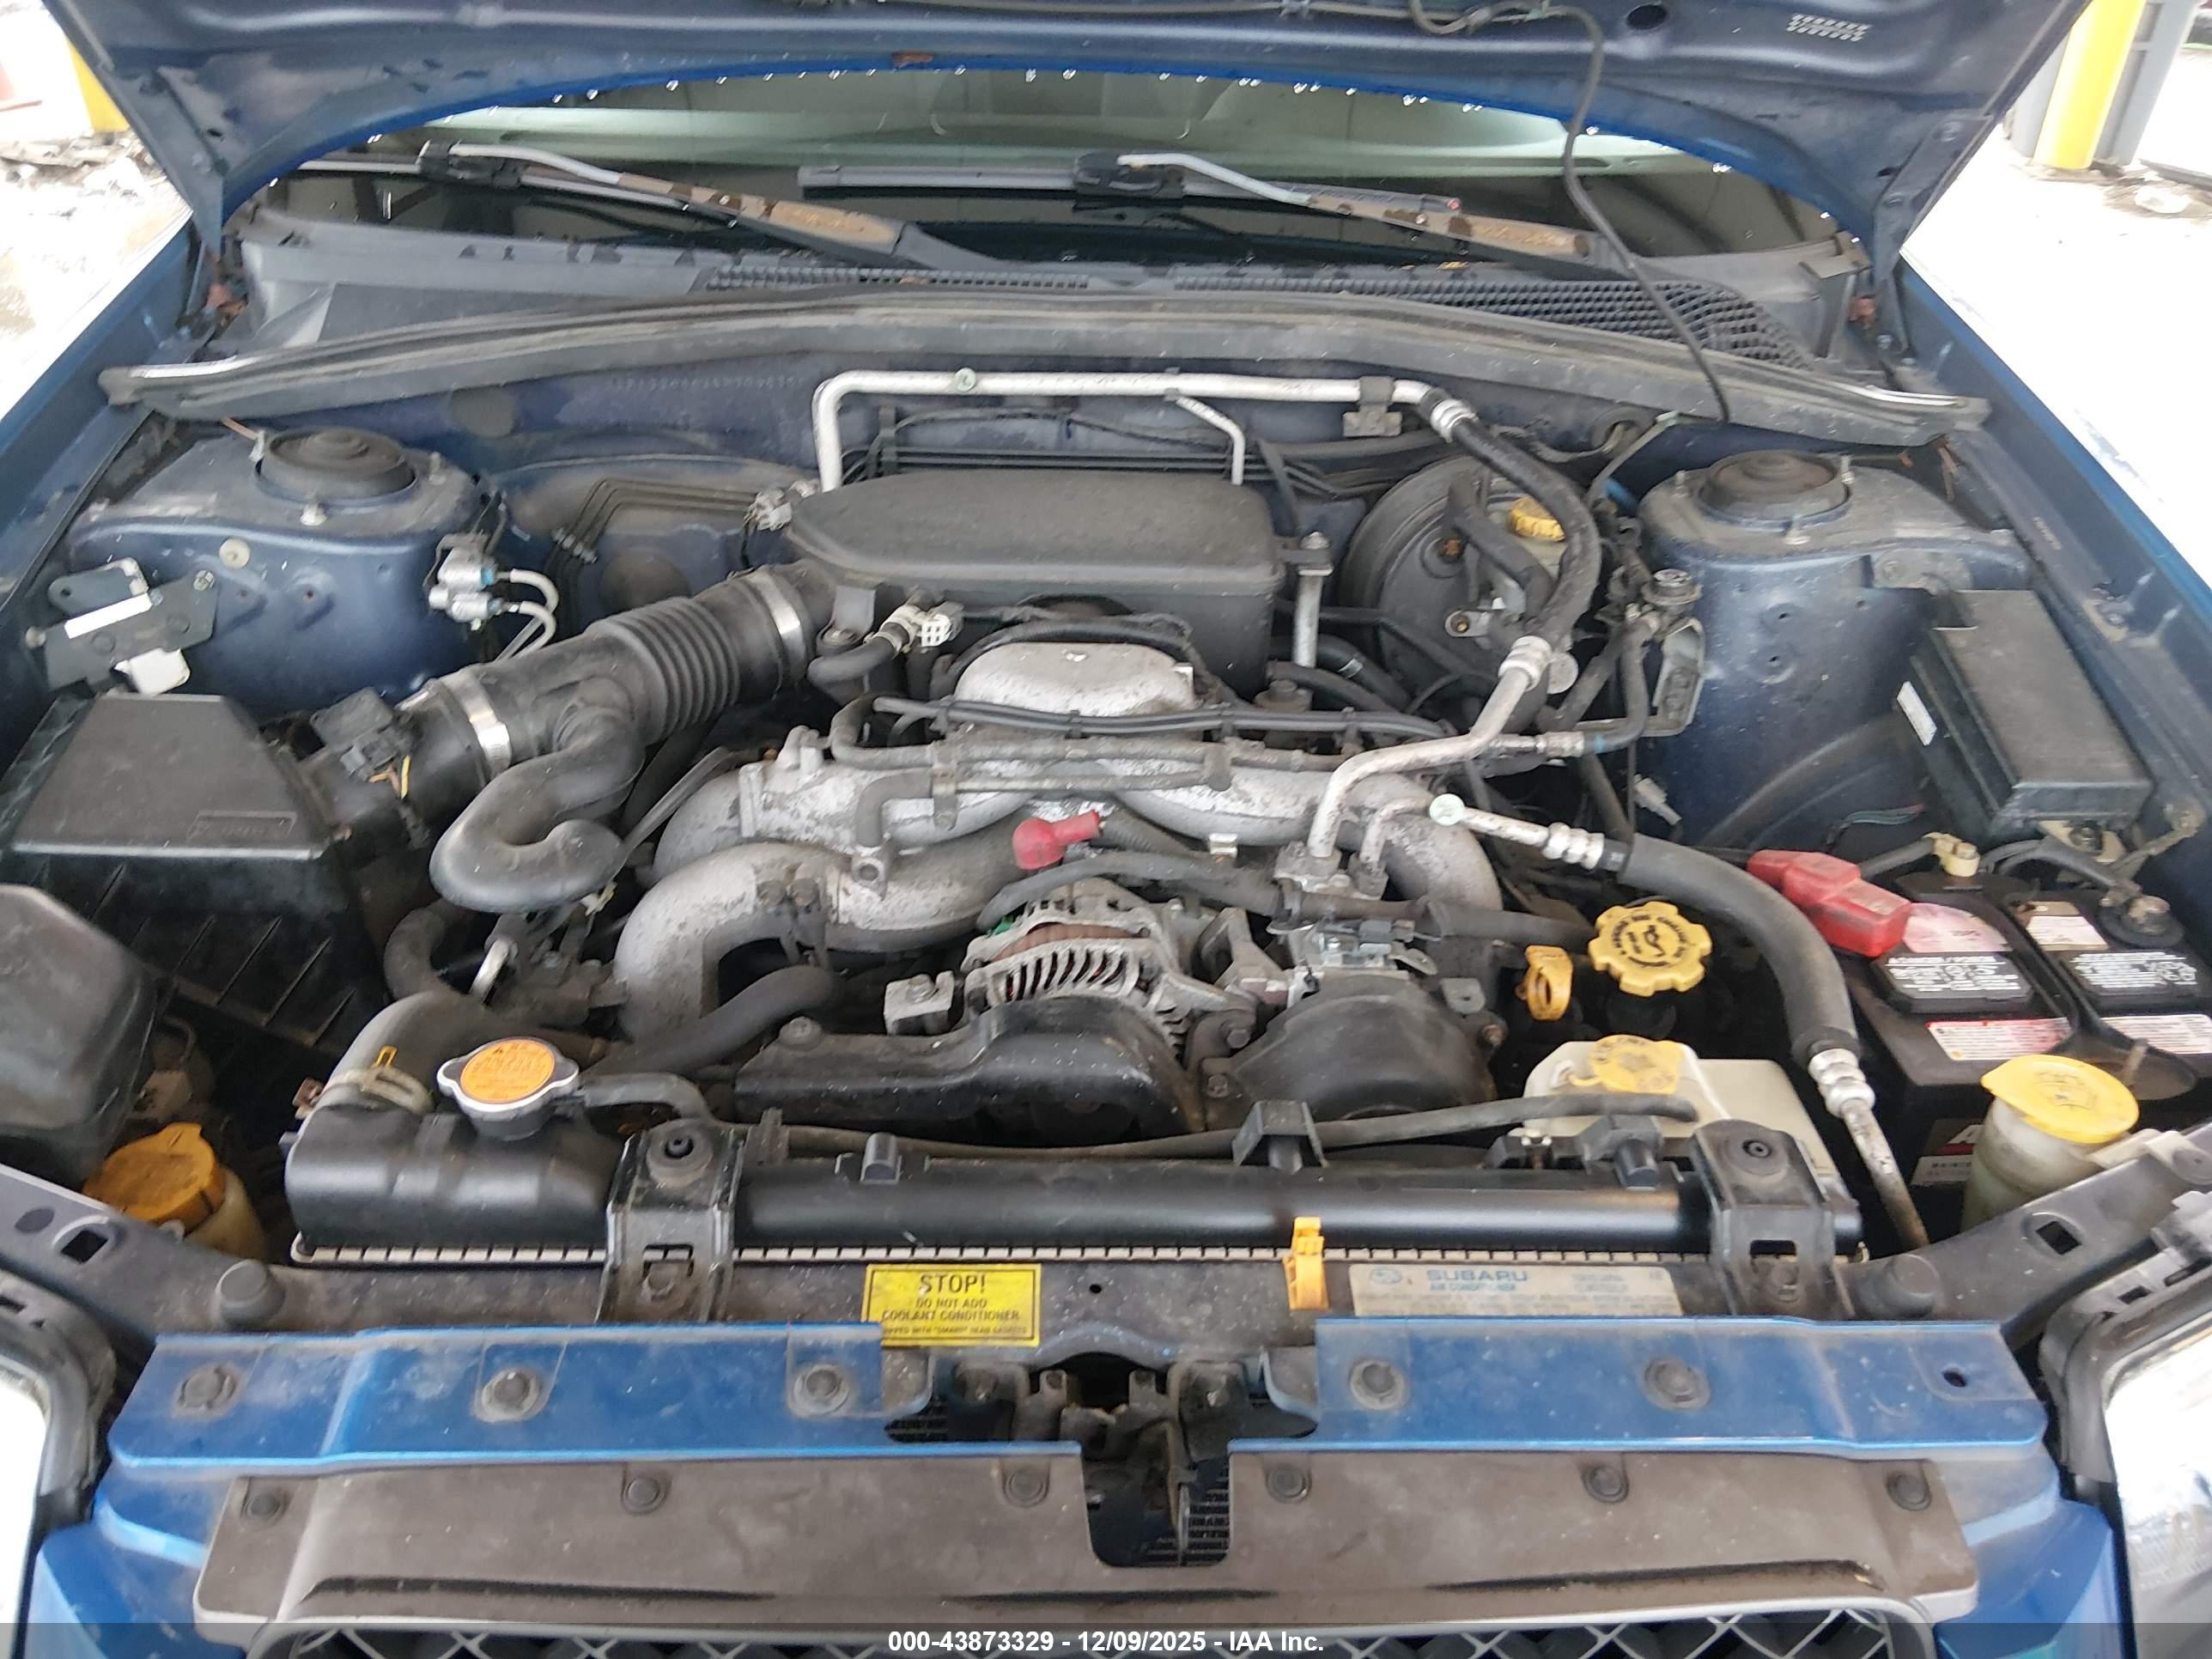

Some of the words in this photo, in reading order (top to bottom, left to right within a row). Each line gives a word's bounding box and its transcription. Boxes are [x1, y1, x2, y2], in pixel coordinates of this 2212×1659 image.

[1426, 1270, 1528, 1282] SUBARU
[919, 1274, 986, 1293] STOP!
[915, 1297, 932, 1308] DO
[936, 1297, 958, 1308] NOT
[962, 1297, 988, 1308] ADD
[881, 1310, 936, 1322] COOLANT
[939, 1310, 1020, 1321] CONDITIONER
